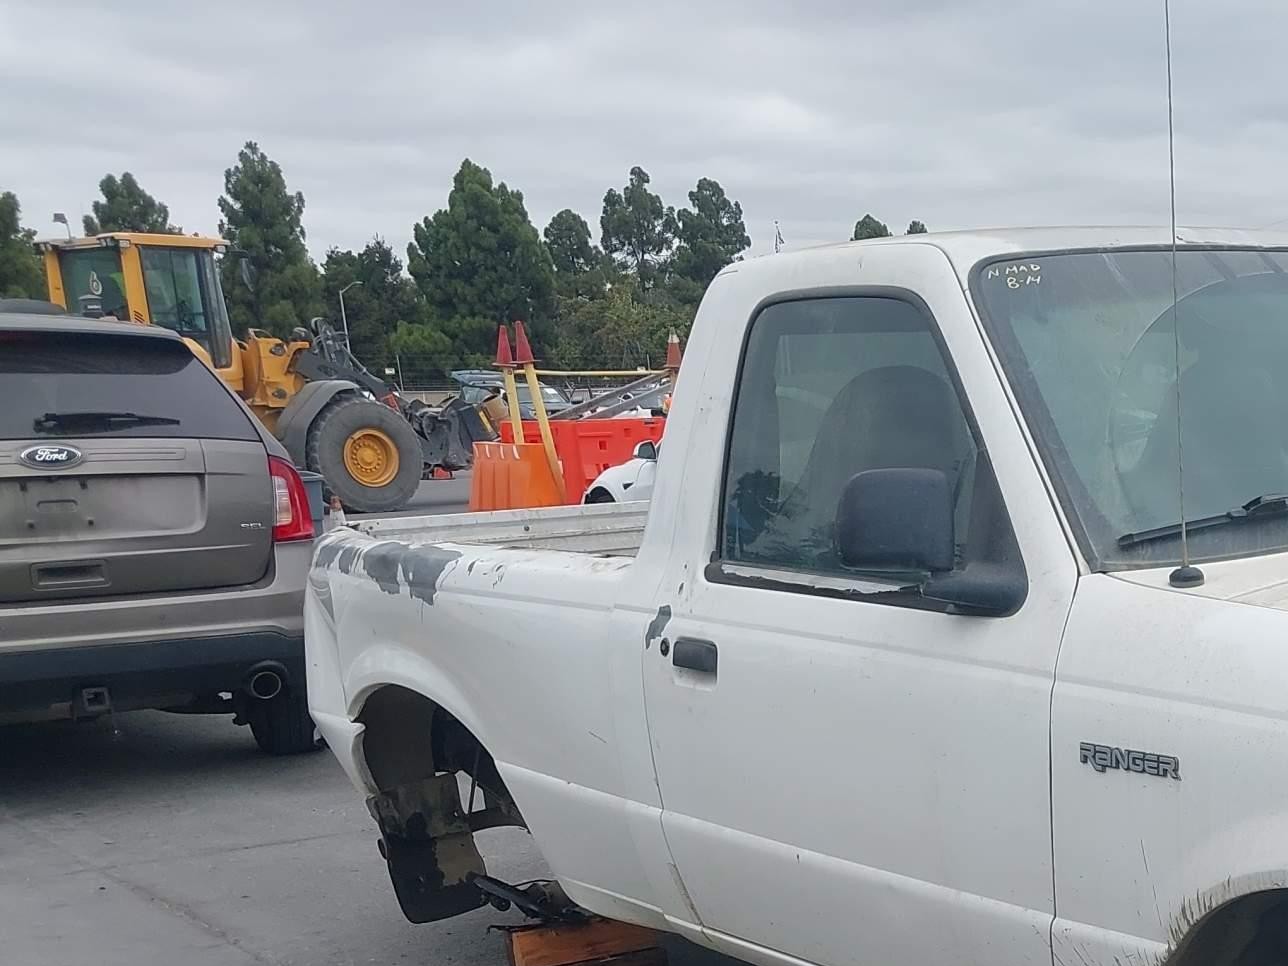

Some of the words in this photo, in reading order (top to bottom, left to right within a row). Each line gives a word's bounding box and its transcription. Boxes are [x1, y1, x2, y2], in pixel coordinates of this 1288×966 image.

[1007, 275, 1041, 289] 8-14
[35, 449, 68, 462] Ford
[1080, 742, 1182, 780] RANGER
